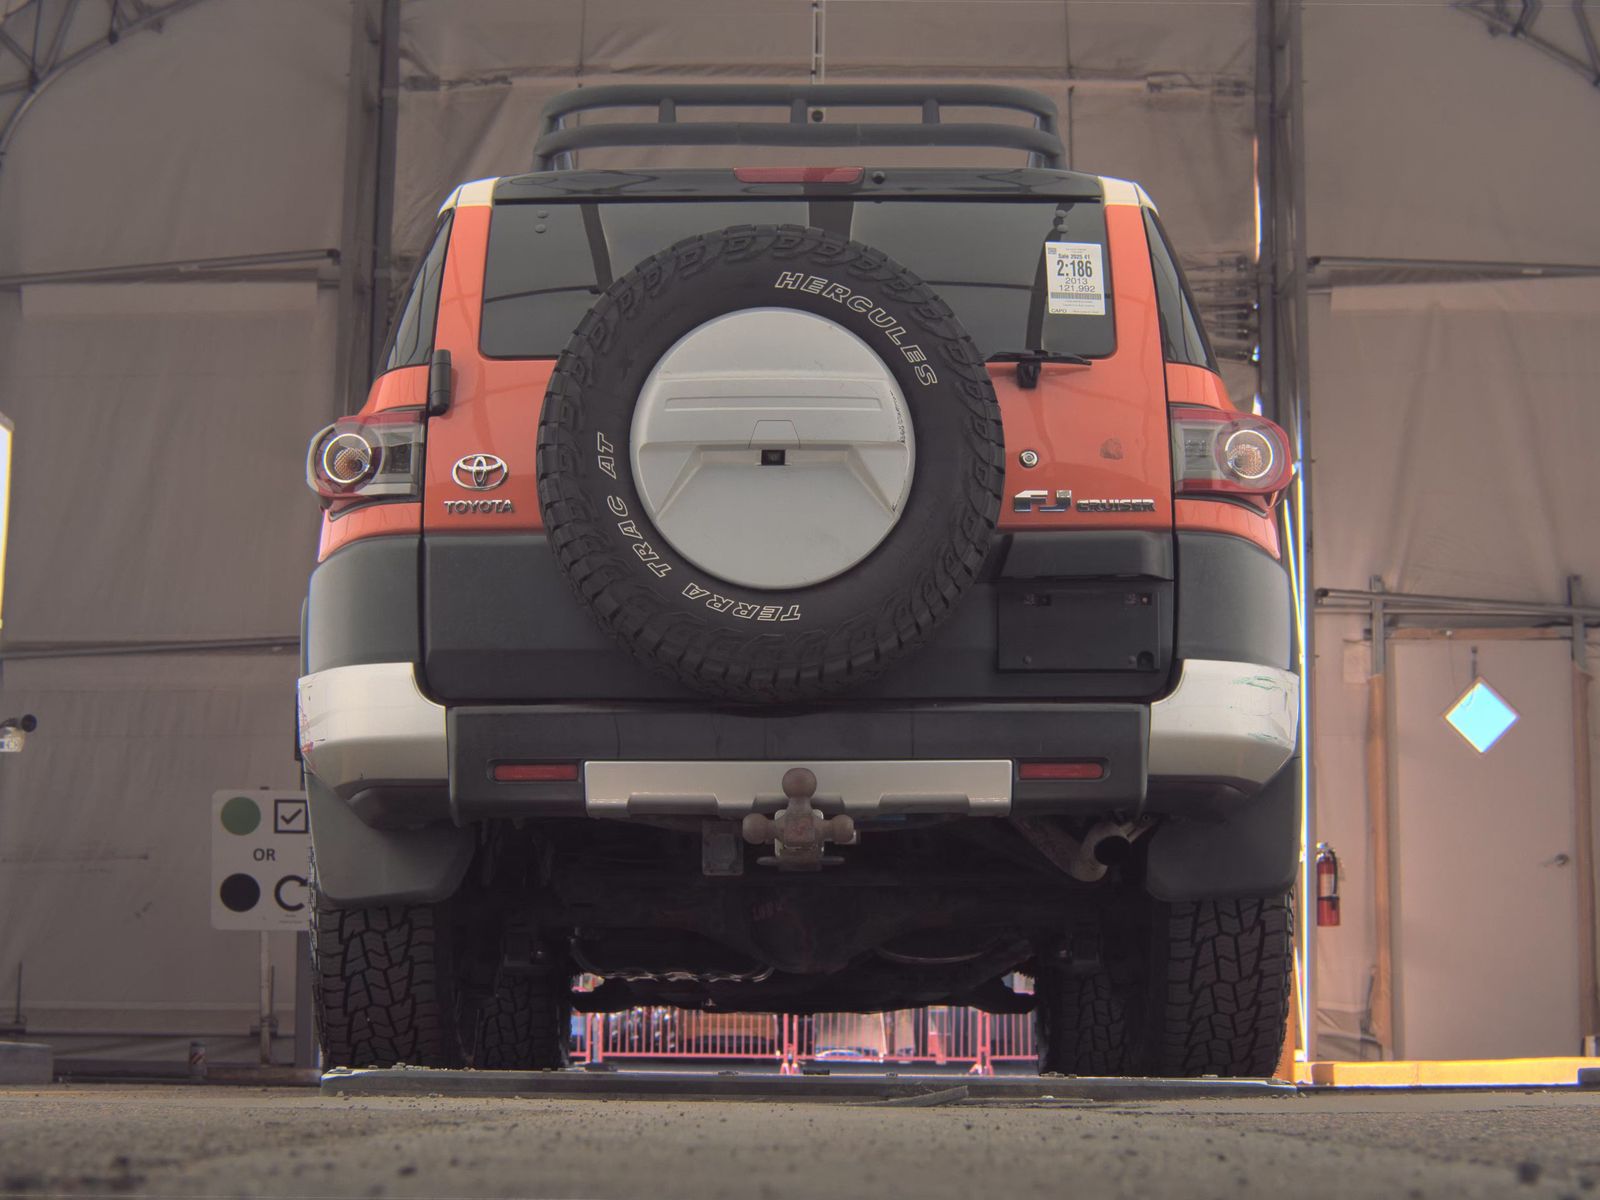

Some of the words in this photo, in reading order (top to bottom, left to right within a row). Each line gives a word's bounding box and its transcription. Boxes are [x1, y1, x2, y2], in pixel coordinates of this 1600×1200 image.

[1057, 260, 1093, 277] 2:186
[1065, 277, 1088, 285] 2013
[774, 271, 938, 387] HERCULES
[597, 432, 617, 479] AT
[443, 499, 513, 514] TOYOTA
[1014, 489, 1072, 512] FJ
[1077, 498, 1155, 512] CRUISER
[607, 495, 672, 578] TRAC
[682, 582, 801, 622] TERRA
[252, 848, 276, 861] OR
